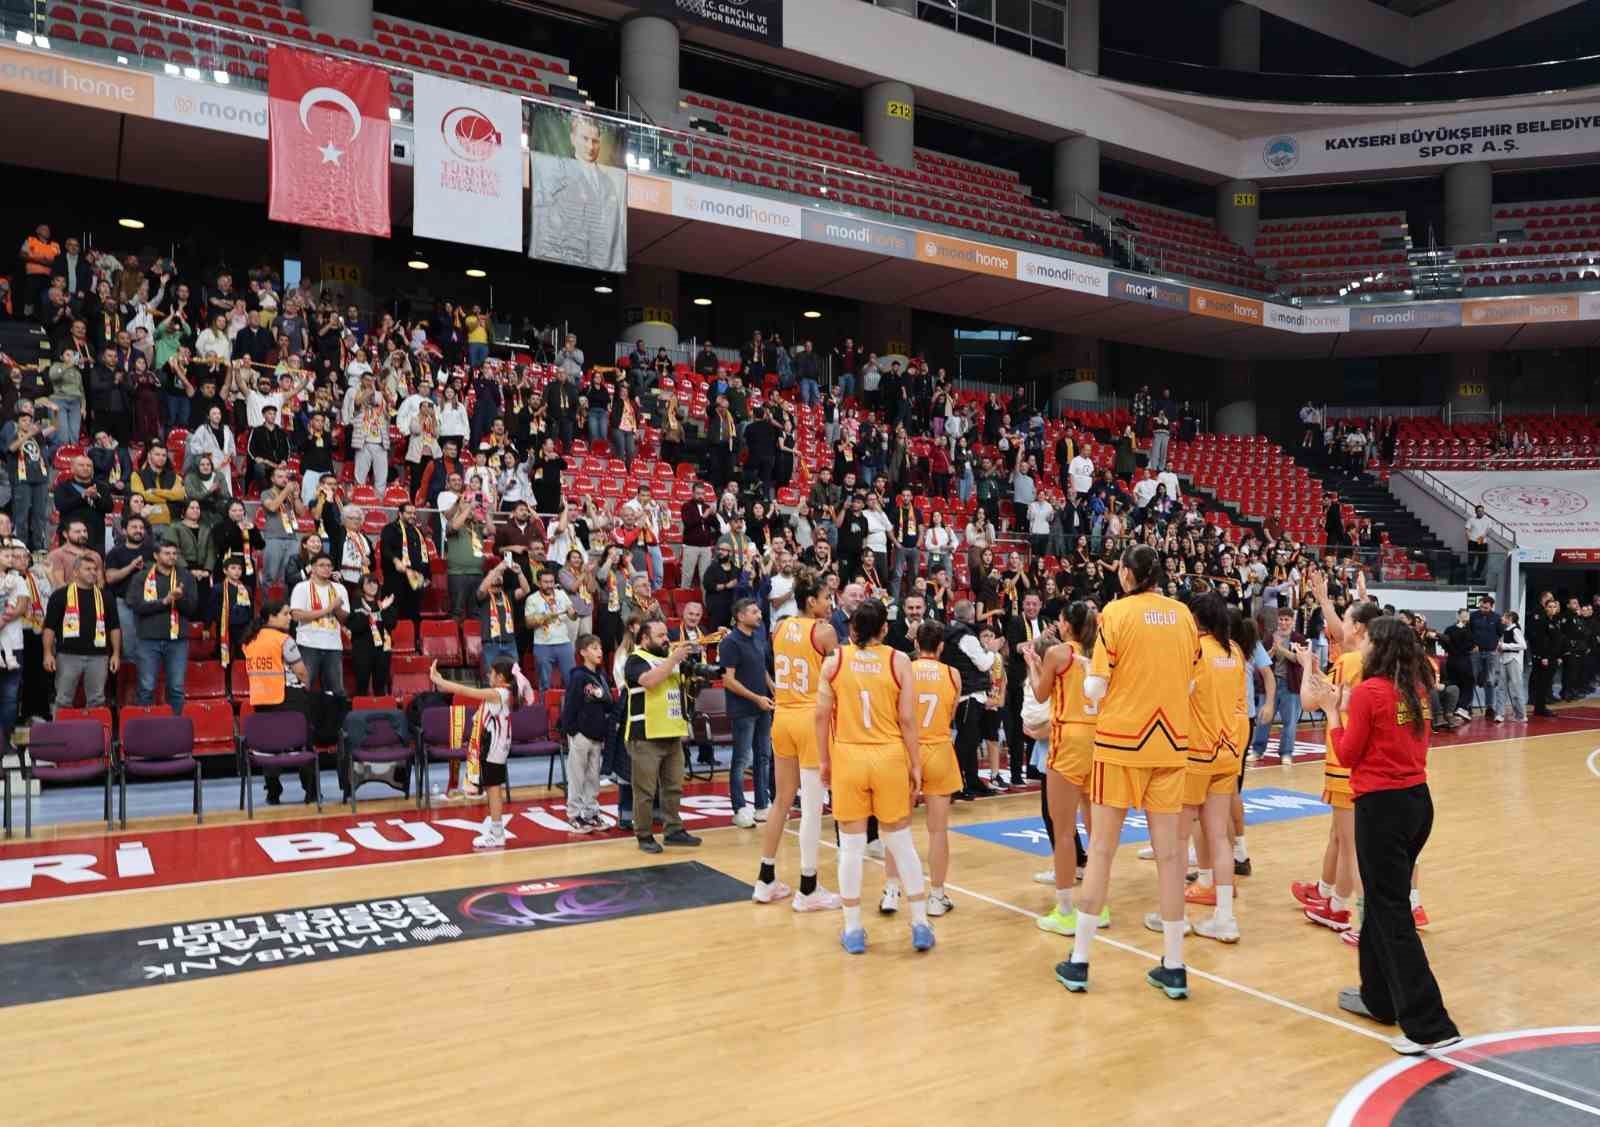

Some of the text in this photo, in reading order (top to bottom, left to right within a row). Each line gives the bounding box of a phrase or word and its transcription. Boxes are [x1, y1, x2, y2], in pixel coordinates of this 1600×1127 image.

[702, 9, 723, 23] SPOR
[718, 4, 754, 20] GENÇLİK
[757, 15, 768, 25] VE
[890, 103, 911, 117] 212
[1325, 133, 1396, 151] KAYSERİ
[1400, 122, 1512, 146] BÜYÜKŞEHİR
[1419, 143, 1473, 158] SPOR
[774, 655, 809, 692] 23
[860, 690, 873, 729] 1
[918, 693, 938, 728] 7
[143, 931, 408, 979] HALKBANK
